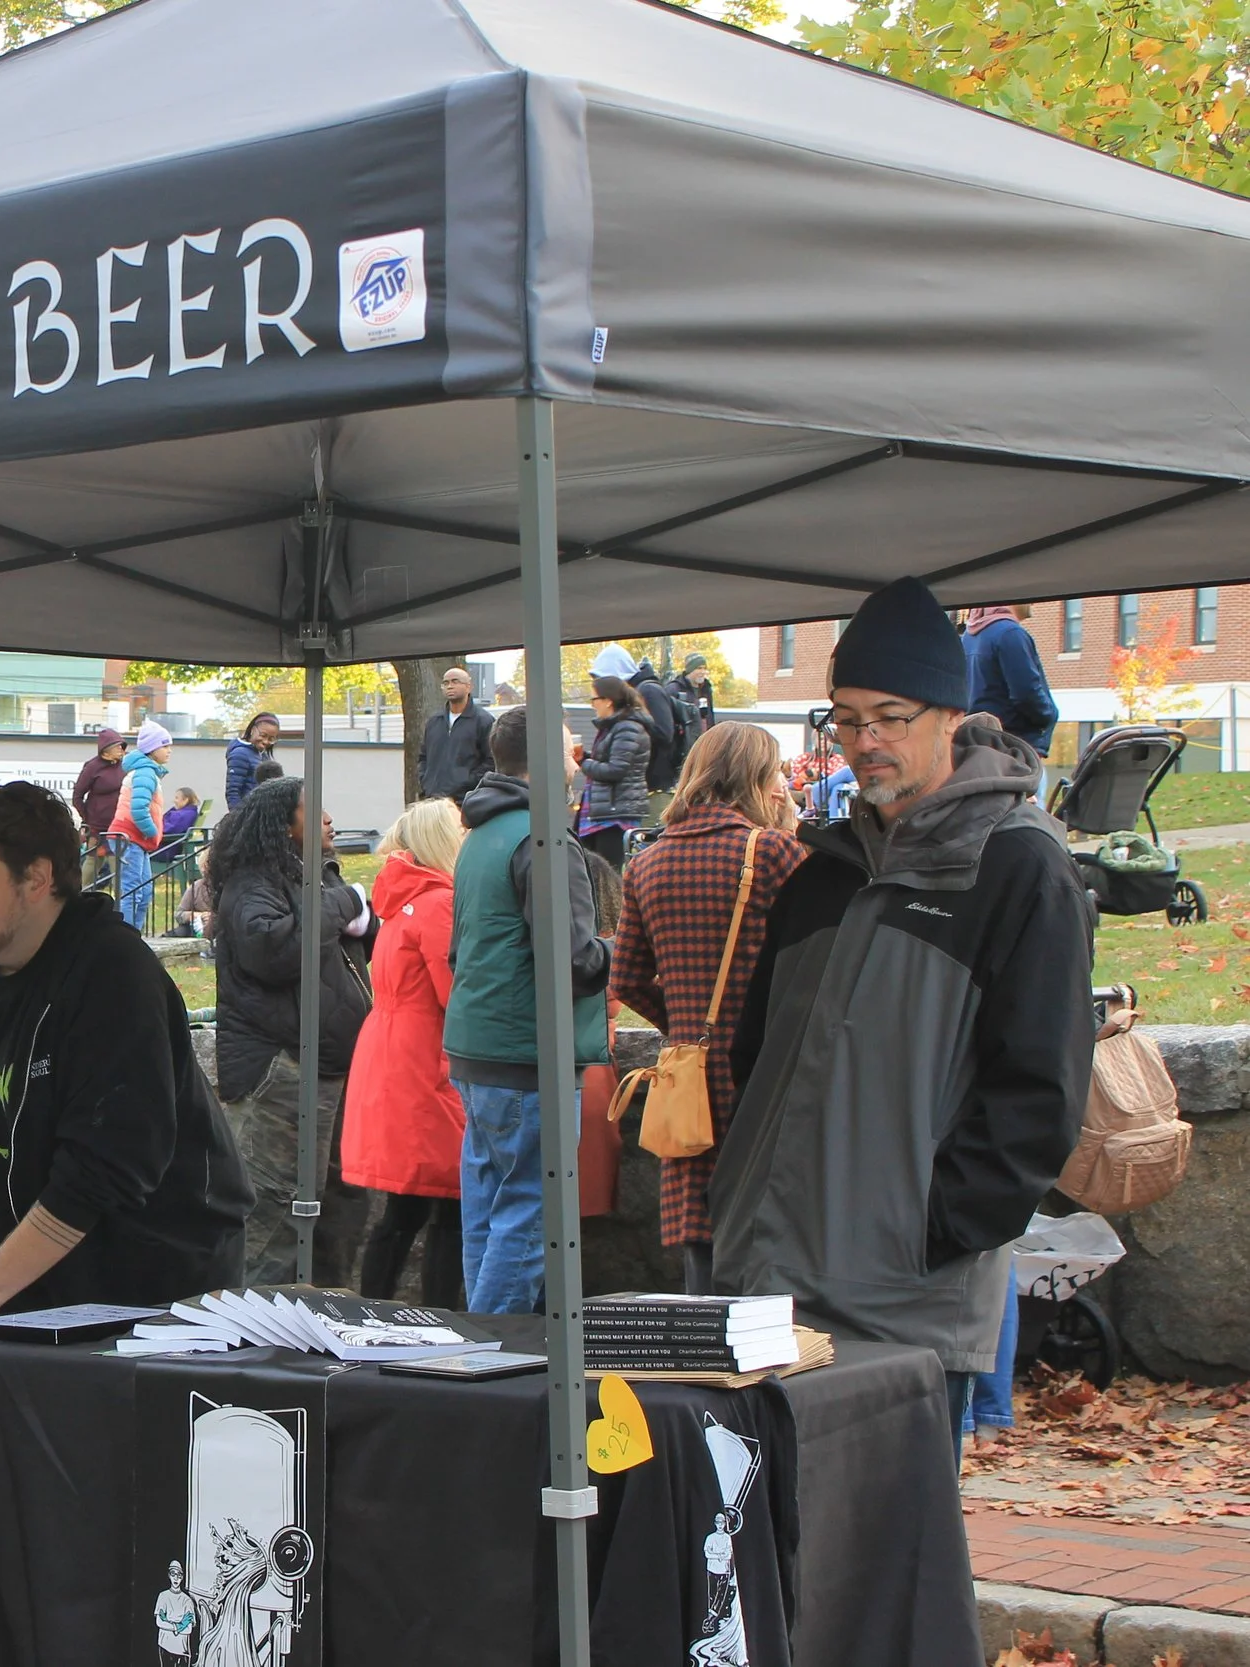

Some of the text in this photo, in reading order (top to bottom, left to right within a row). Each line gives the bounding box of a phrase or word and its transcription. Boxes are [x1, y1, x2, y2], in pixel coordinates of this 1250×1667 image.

[7, 218, 316, 398] BEER
[34, 779, 76, 790] BUILD
[598, 1414, 630, 1459] $25
